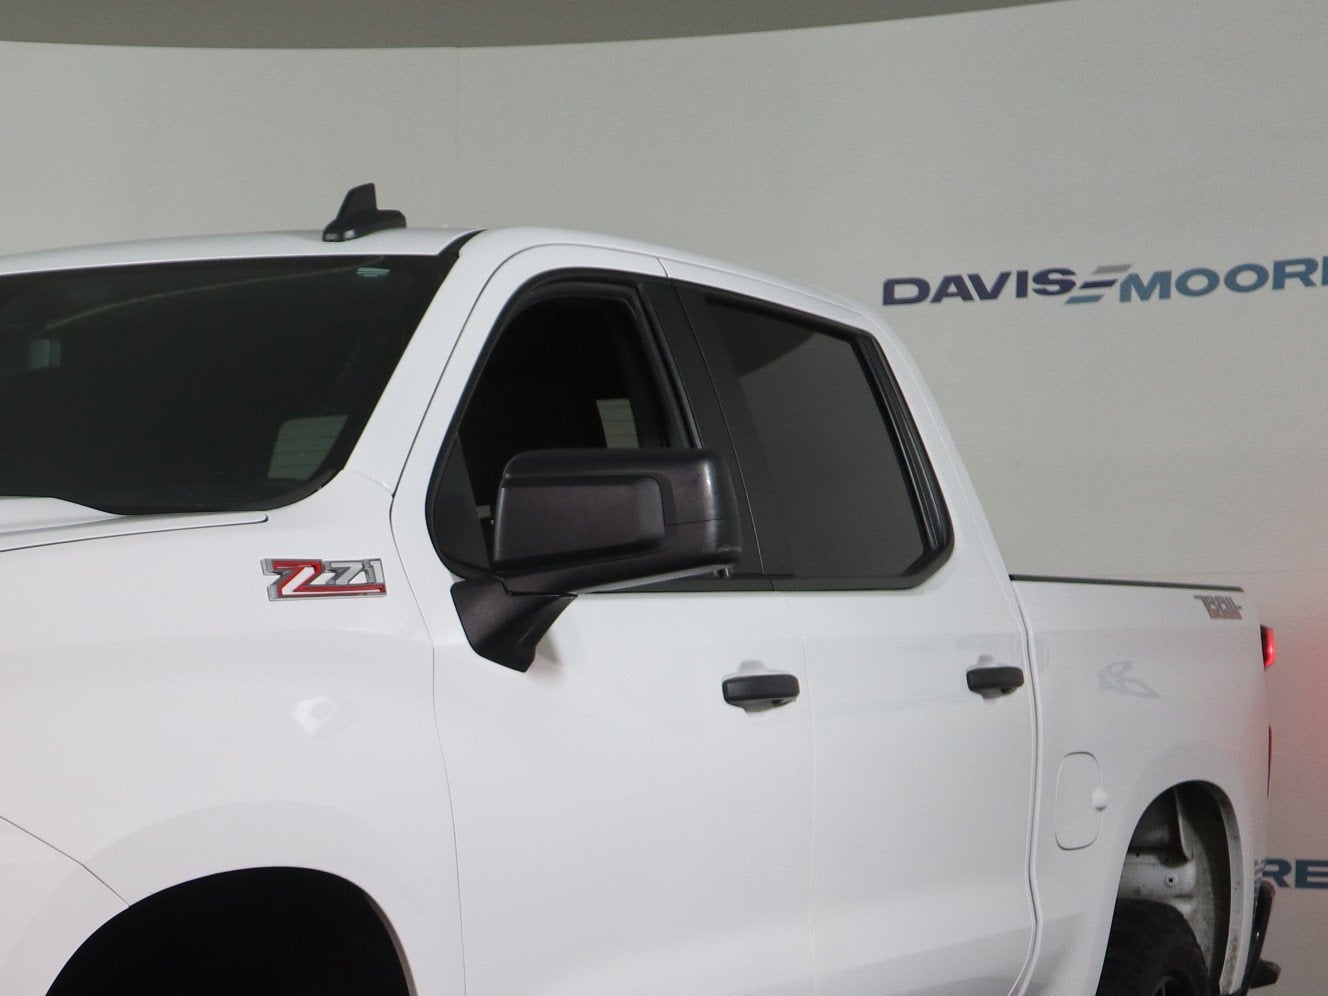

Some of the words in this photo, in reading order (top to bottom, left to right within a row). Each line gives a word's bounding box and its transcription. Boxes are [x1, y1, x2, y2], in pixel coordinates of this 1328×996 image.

[882, 267, 1076, 306] DAVIS
[1119, 256, 1328, 302] MOOR
[260, 558, 387, 601] Z71
